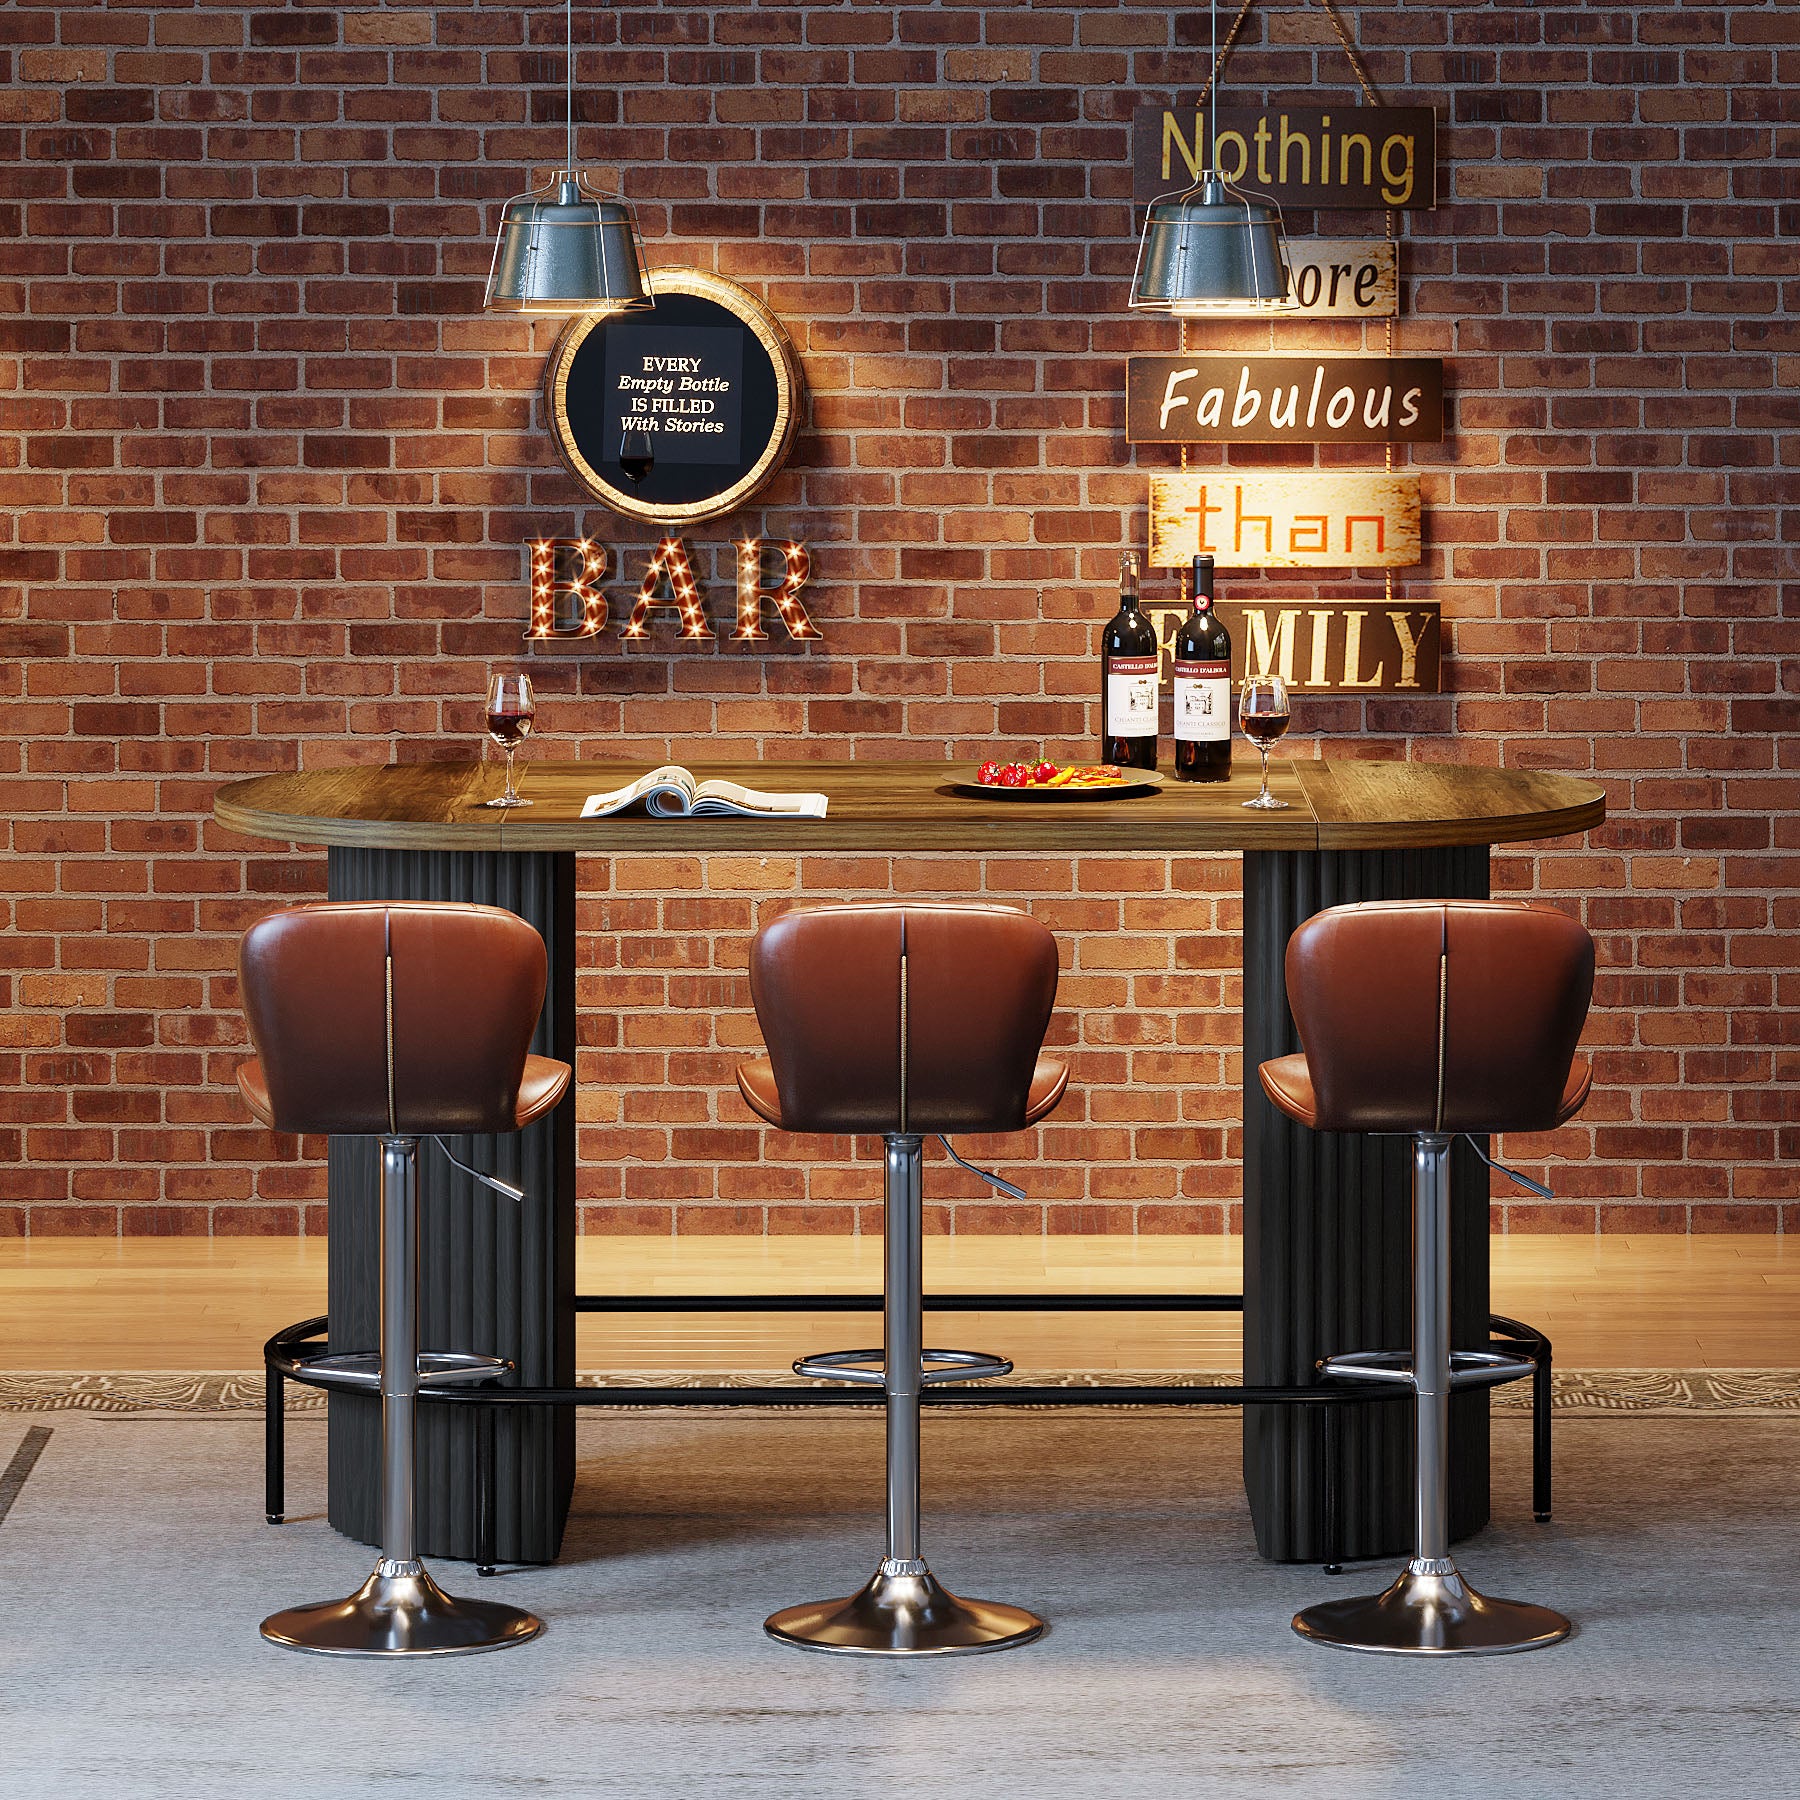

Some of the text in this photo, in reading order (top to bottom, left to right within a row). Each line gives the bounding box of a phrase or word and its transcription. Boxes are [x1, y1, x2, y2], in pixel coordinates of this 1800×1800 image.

[1161, 111, 1415, 205] Nothing
[1279, 262, 1378, 308] ore
[617, 375, 730, 395] Empty Bottle
[642, 356, 702, 373] EVERY
[620, 416, 725, 434] With Stories
[631, 397, 715, 414] IS FILLED
[1159, 365, 1422, 430] Fabulous
[1184, 485, 1386, 553] than
[522, 536, 824, 641] BAR
[1146, 608, 1438, 689] FMILY
